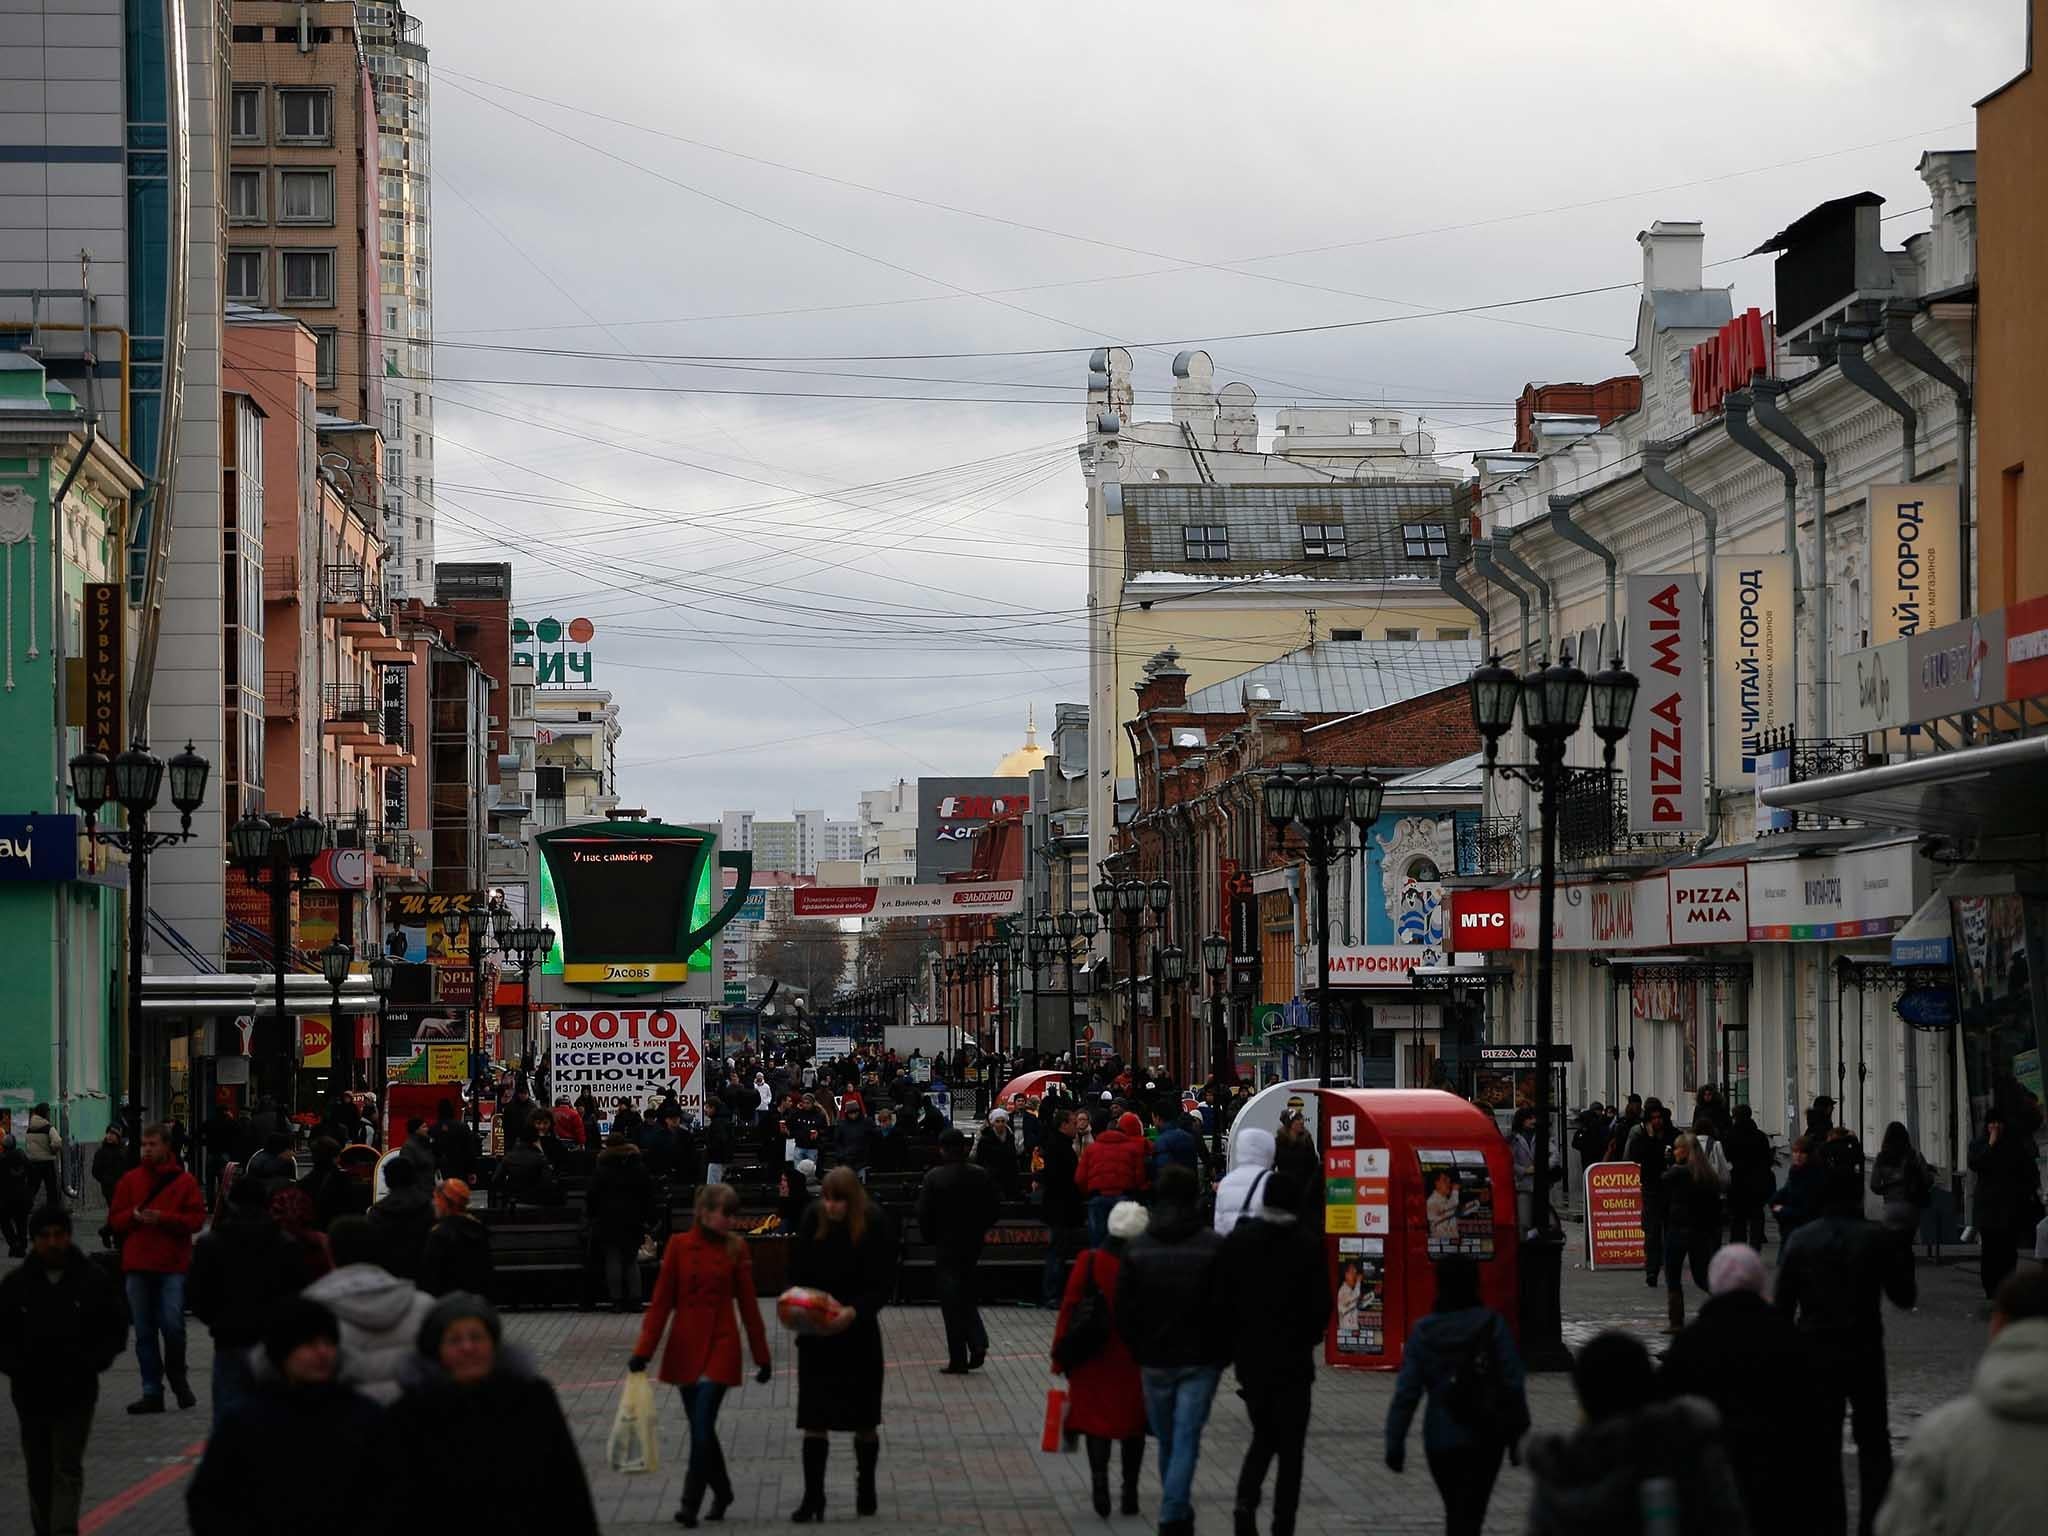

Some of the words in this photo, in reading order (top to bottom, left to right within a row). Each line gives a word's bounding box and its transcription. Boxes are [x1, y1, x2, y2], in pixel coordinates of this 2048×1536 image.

[1892, 501, 1923, 638] АЙ-ГОРОД
[96, 587, 111, 664] ОБУВЬ
[1648, 583, 1681, 677] MIA
[1735, 569, 1762, 734] ЧИТАЙ-ГОРОД
[1650, 692, 1682, 822] PIZZA
[573, 852, 582, 862] У
[582, 854, 601, 862] нас
[603, 851, 638, 862] самый
[1676, 887, 1741, 904] PIZZA
[1461, 912, 1505, 928] МТС
[1591, 892, 1616, 941] PIZZA
[1617, 892, 1634, 938] MIA
[1687, 907, 1732, 923] MIA
[443, 971, 474, 983] ОРЫ
[555, 1011, 677, 1040] ФОТО
[571, 1041, 628, 1050] документы
[632, 1039, 640, 1047] 5
[676, 1044, 690, 1060] 2
[556, 1052, 665, 1066] КСЕРОКС
[1481, 1049, 1516, 1059] PIZZA
[671, 1061, 695, 1069] ЭТАЖ
[556, 1068, 666, 1081] КЛЮЧИ
[1336, 1119, 1350, 1132] 3G
[1592, 1173, 1643, 1187] СКУПКА
[1602, 1199, 1636, 1209] ОБМЕН
